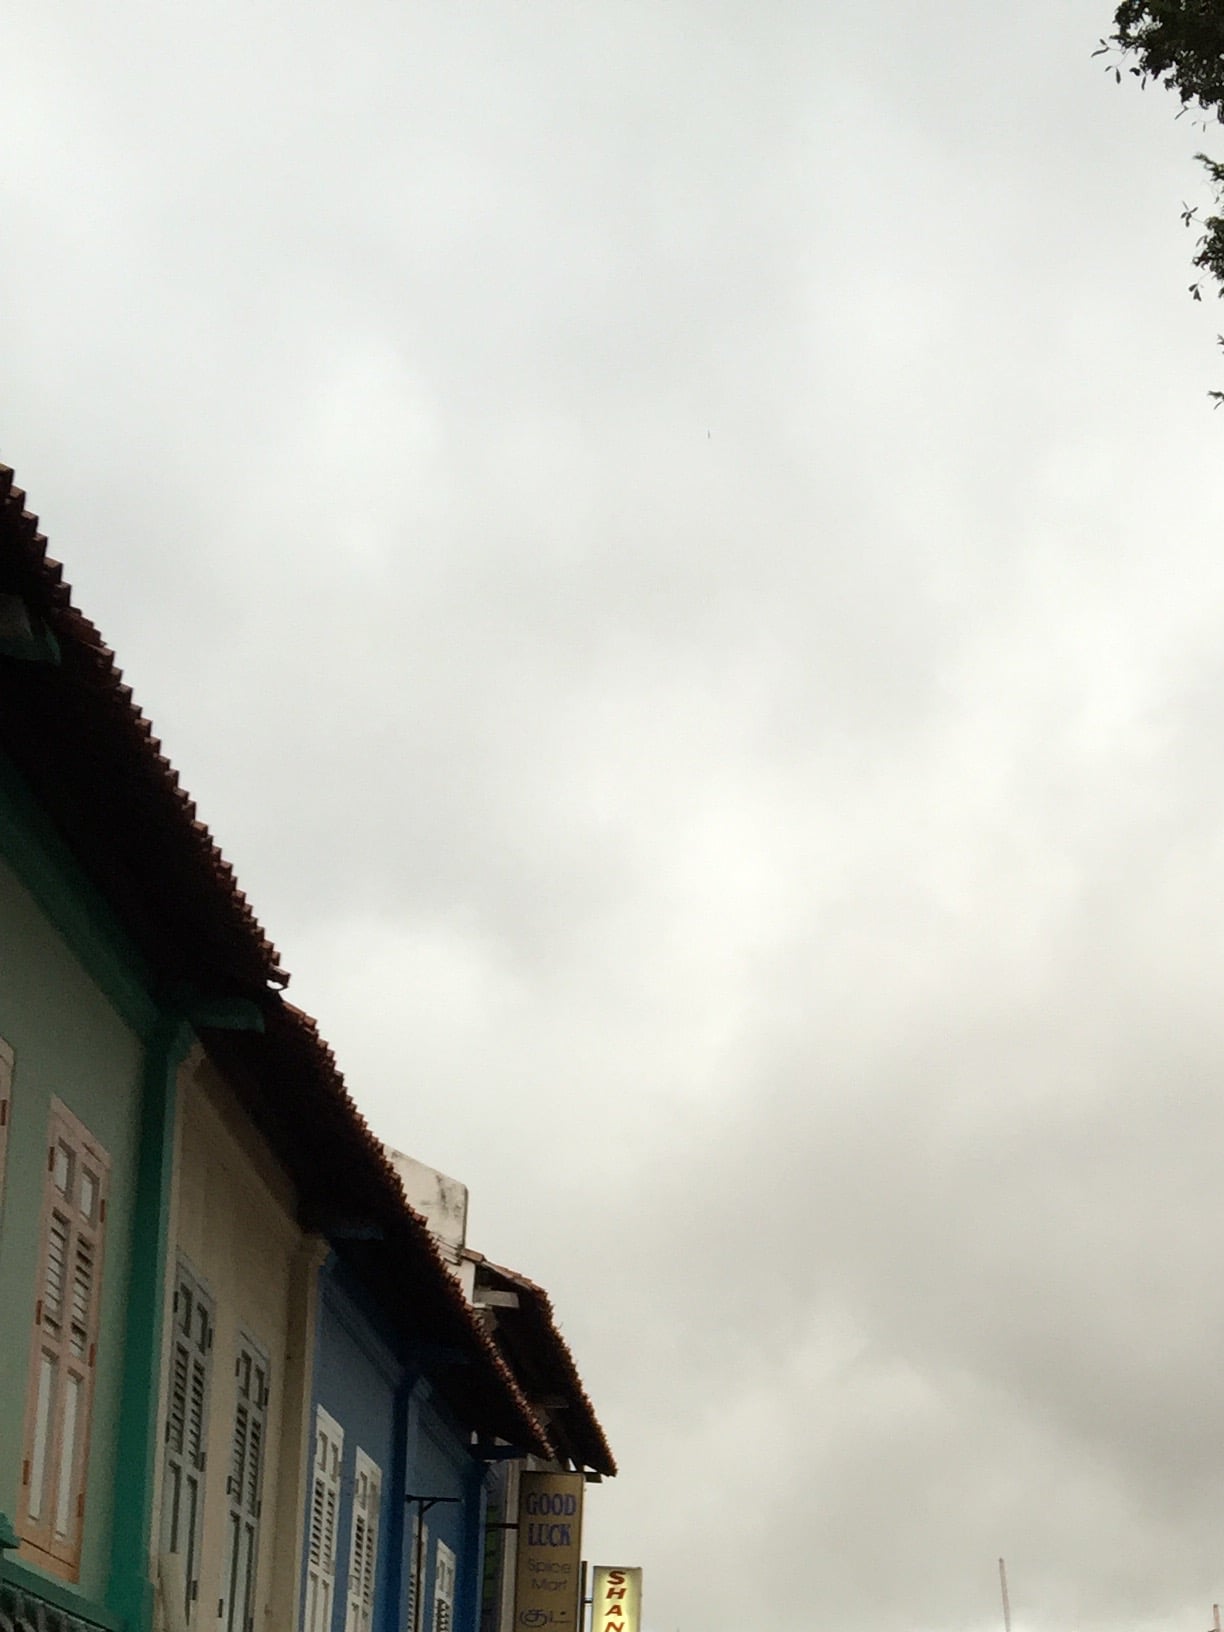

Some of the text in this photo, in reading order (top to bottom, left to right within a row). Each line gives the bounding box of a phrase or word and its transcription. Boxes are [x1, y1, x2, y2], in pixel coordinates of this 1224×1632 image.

[526, 1493, 577, 1516] GOOD
[527, 1523, 571, 1547] LUCK
[528, 1559, 572, 1574] Spice
